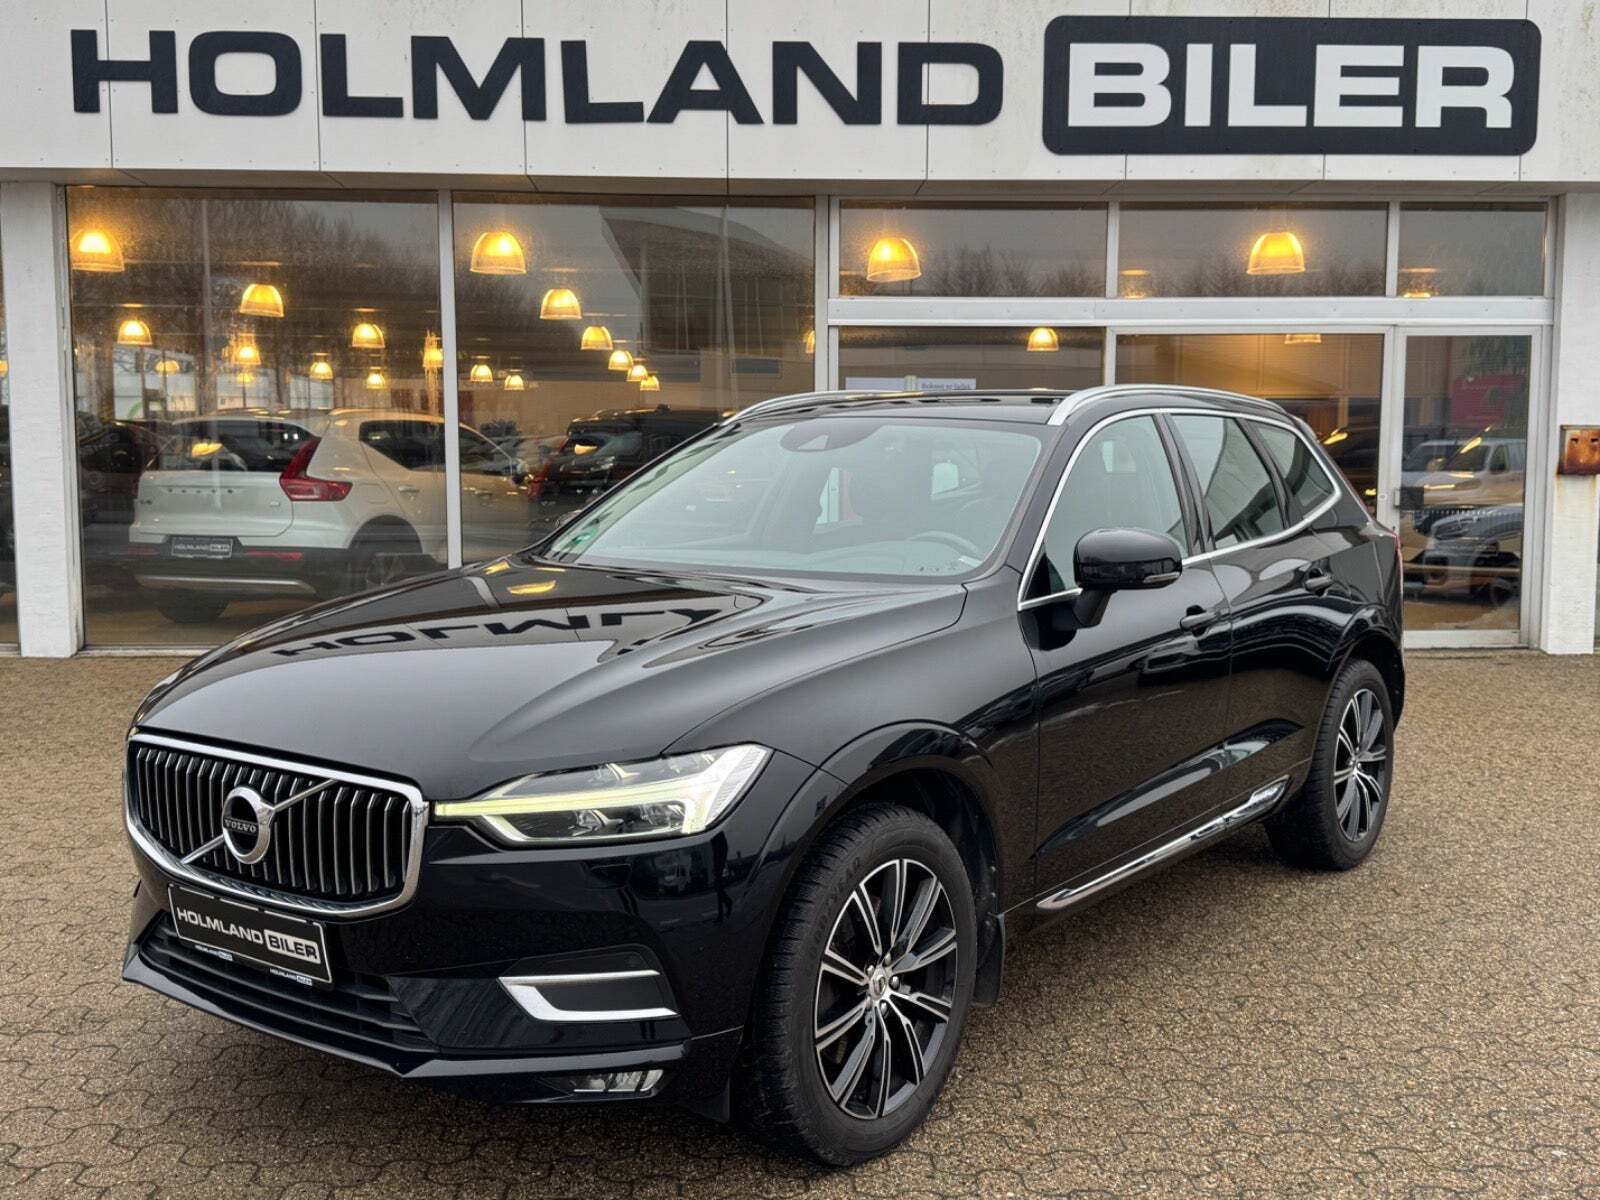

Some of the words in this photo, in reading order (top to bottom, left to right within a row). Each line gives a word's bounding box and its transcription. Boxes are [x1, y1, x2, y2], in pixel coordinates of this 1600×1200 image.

[70, 29, 1004, 127] HOLMLAND
[1067, 42, 1515, 129] BILER
[224, 819, 257, 833] VOLVO
[176, 906, 264, 945] HOLMLAND
[269, 934, 319, 960] BILER
